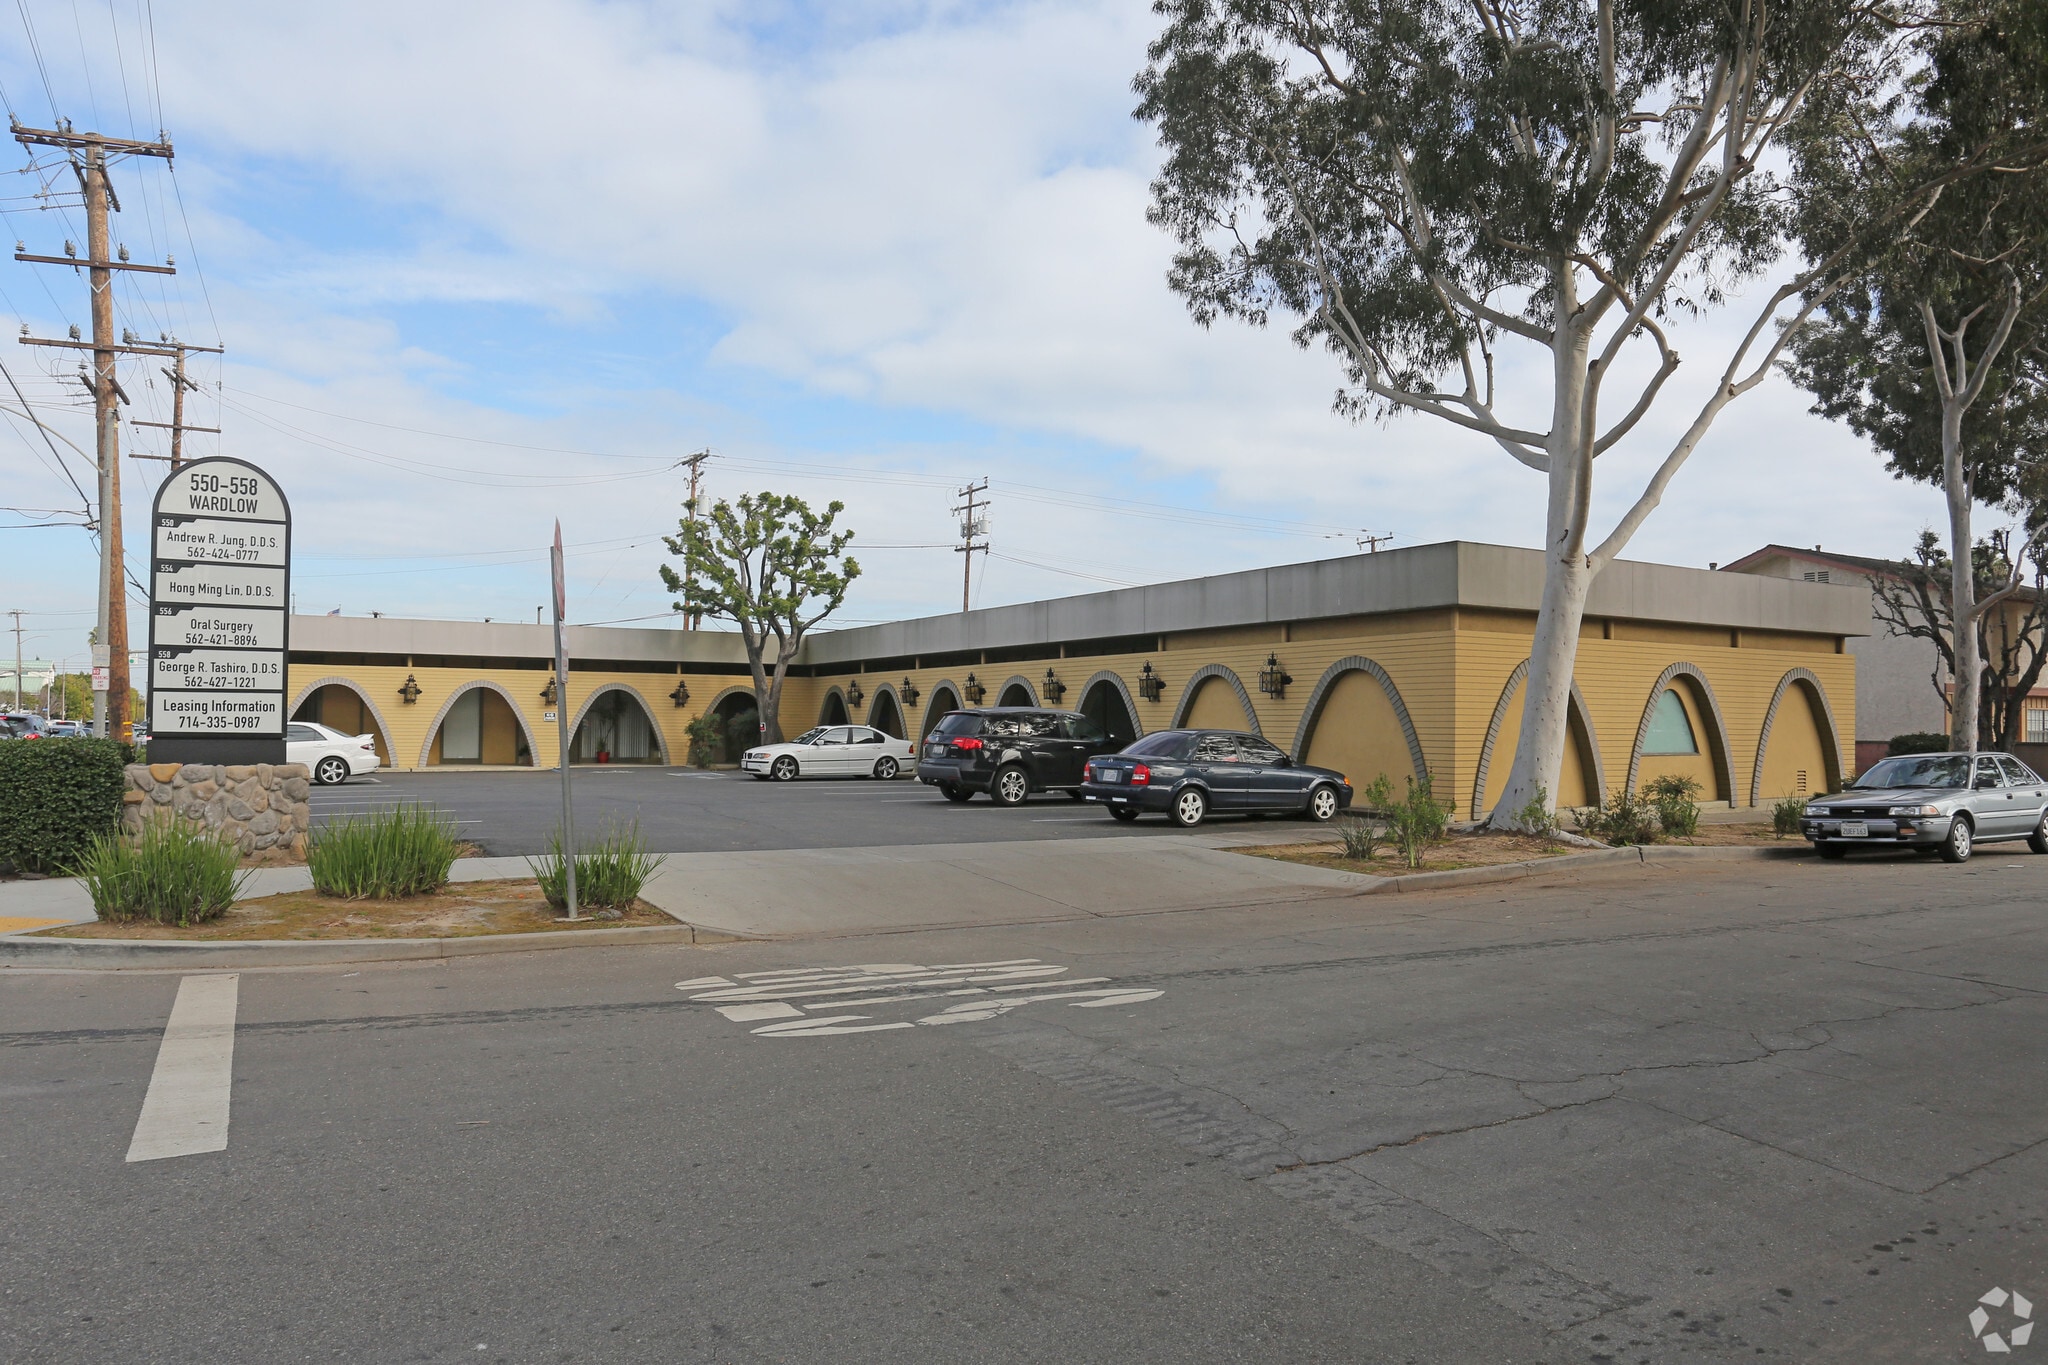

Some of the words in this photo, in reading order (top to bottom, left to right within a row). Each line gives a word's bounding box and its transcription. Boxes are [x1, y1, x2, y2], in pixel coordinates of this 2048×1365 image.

[190, 473, 259, 496] 550-558
[189, 494, 258, 514] WARDLOW
[161, 518, 174, 527] 550
[167, 530, 206, 544] Andrew
[208, 533, 218, 545] R.
[250, 535, 279, 549] D.D.S.
[186, 546, 259, 562] 562-424-0777
[160, 564, 174, 572] 554
[169, 581, 195, 597] Hong
[198, 582, 223, 598] Ming
[246, 585, 275, 598] D.D.S.
[159, 607, 172, 615] 556
[190, 618, 212, 631] Oral
[213, 619, 254, 635] Surgery
[185, 633, 258, 646] 562-421-8896
[158, 650, 171, 658] 558
[159, 660, 196, 674] George
[198, 661, 208, 673] R.
[251, 662, 280, 675] D.D.S.
[184, 675, 256, 688] 562-427-1221
[163, 698, 208, 714] Leasing
[211, 699, 276, 714] Information
[178, 716, 261, 729] 714-335-0987
[675, 958, 1166, 1037] STOP
